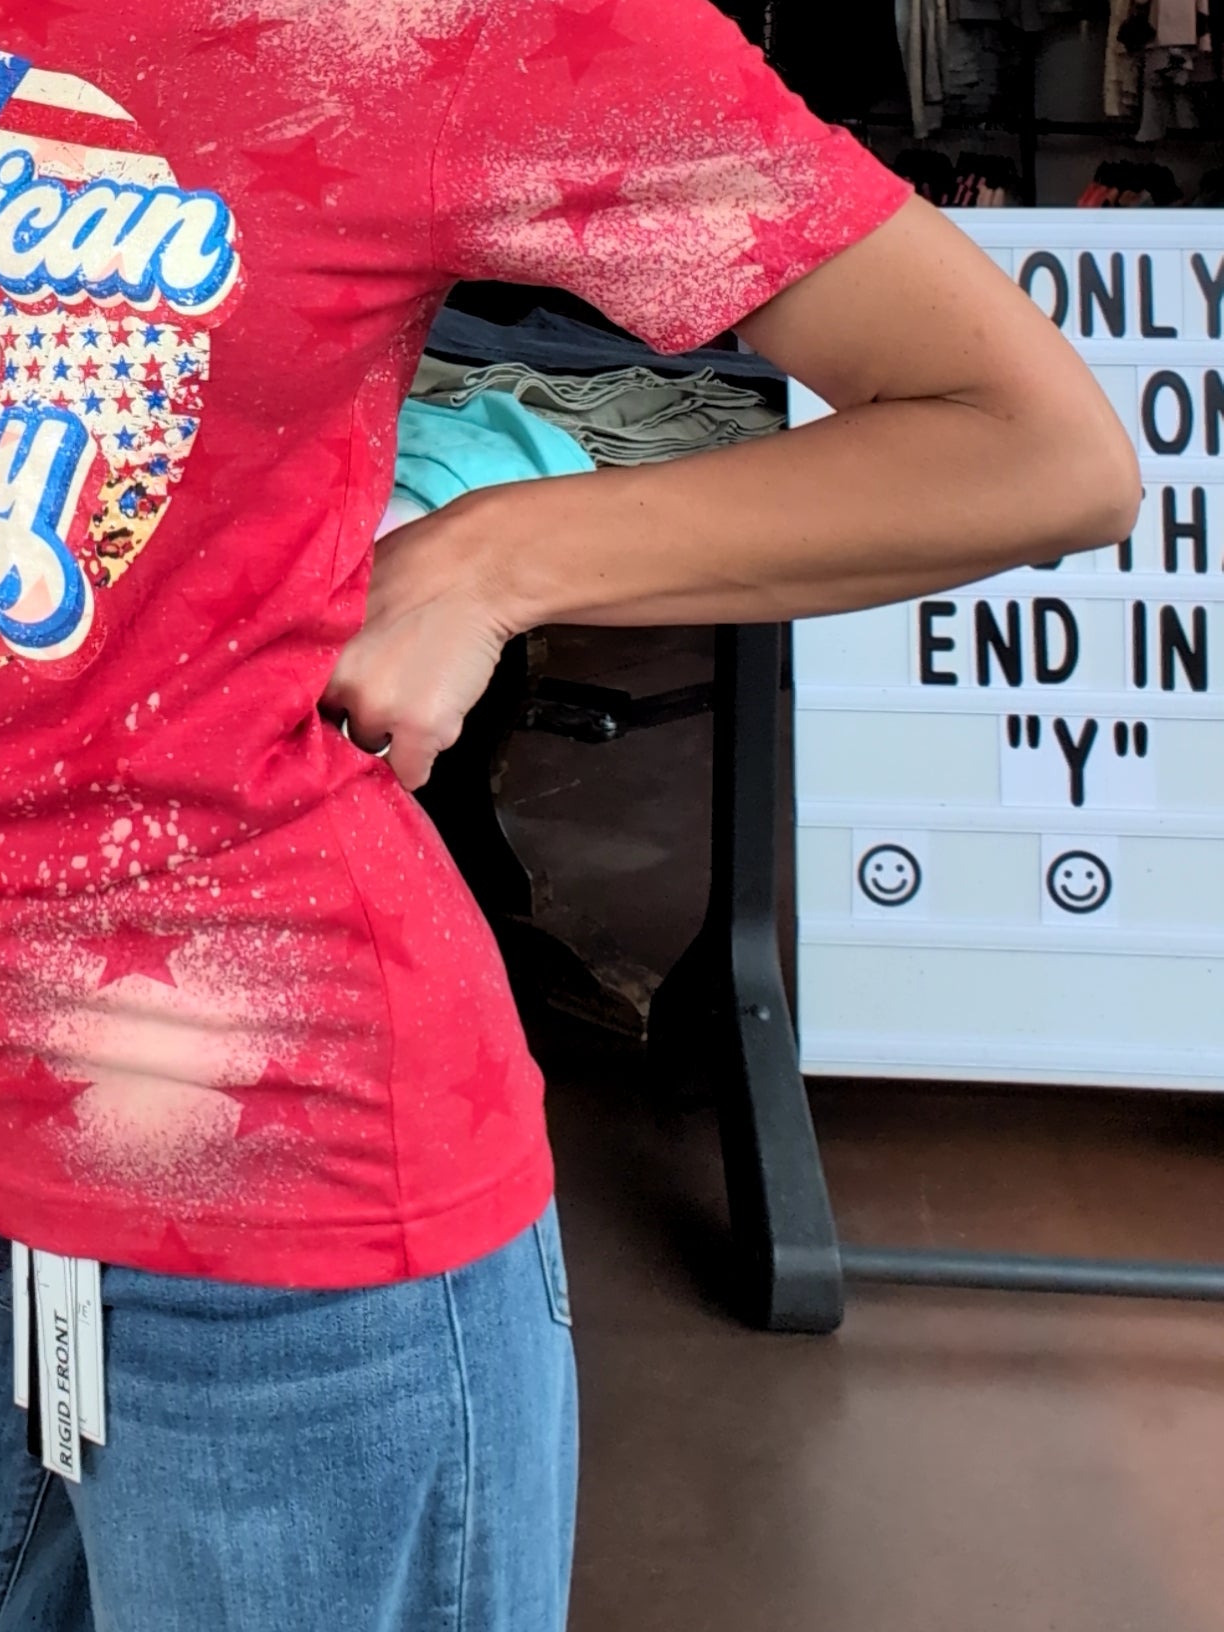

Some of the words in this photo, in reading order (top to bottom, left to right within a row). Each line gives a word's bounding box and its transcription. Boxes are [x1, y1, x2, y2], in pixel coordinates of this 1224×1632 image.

[1019, 251, 1224, 338] ONLY
[919, 597, 1079, 686] END
[1132, 599, 1208, 691] IN
[1006, 714, 1149, 807] "Y"
[55, 1310, 71, 1396] FRONT
[58, 1401, 74, 1468] RIGID
